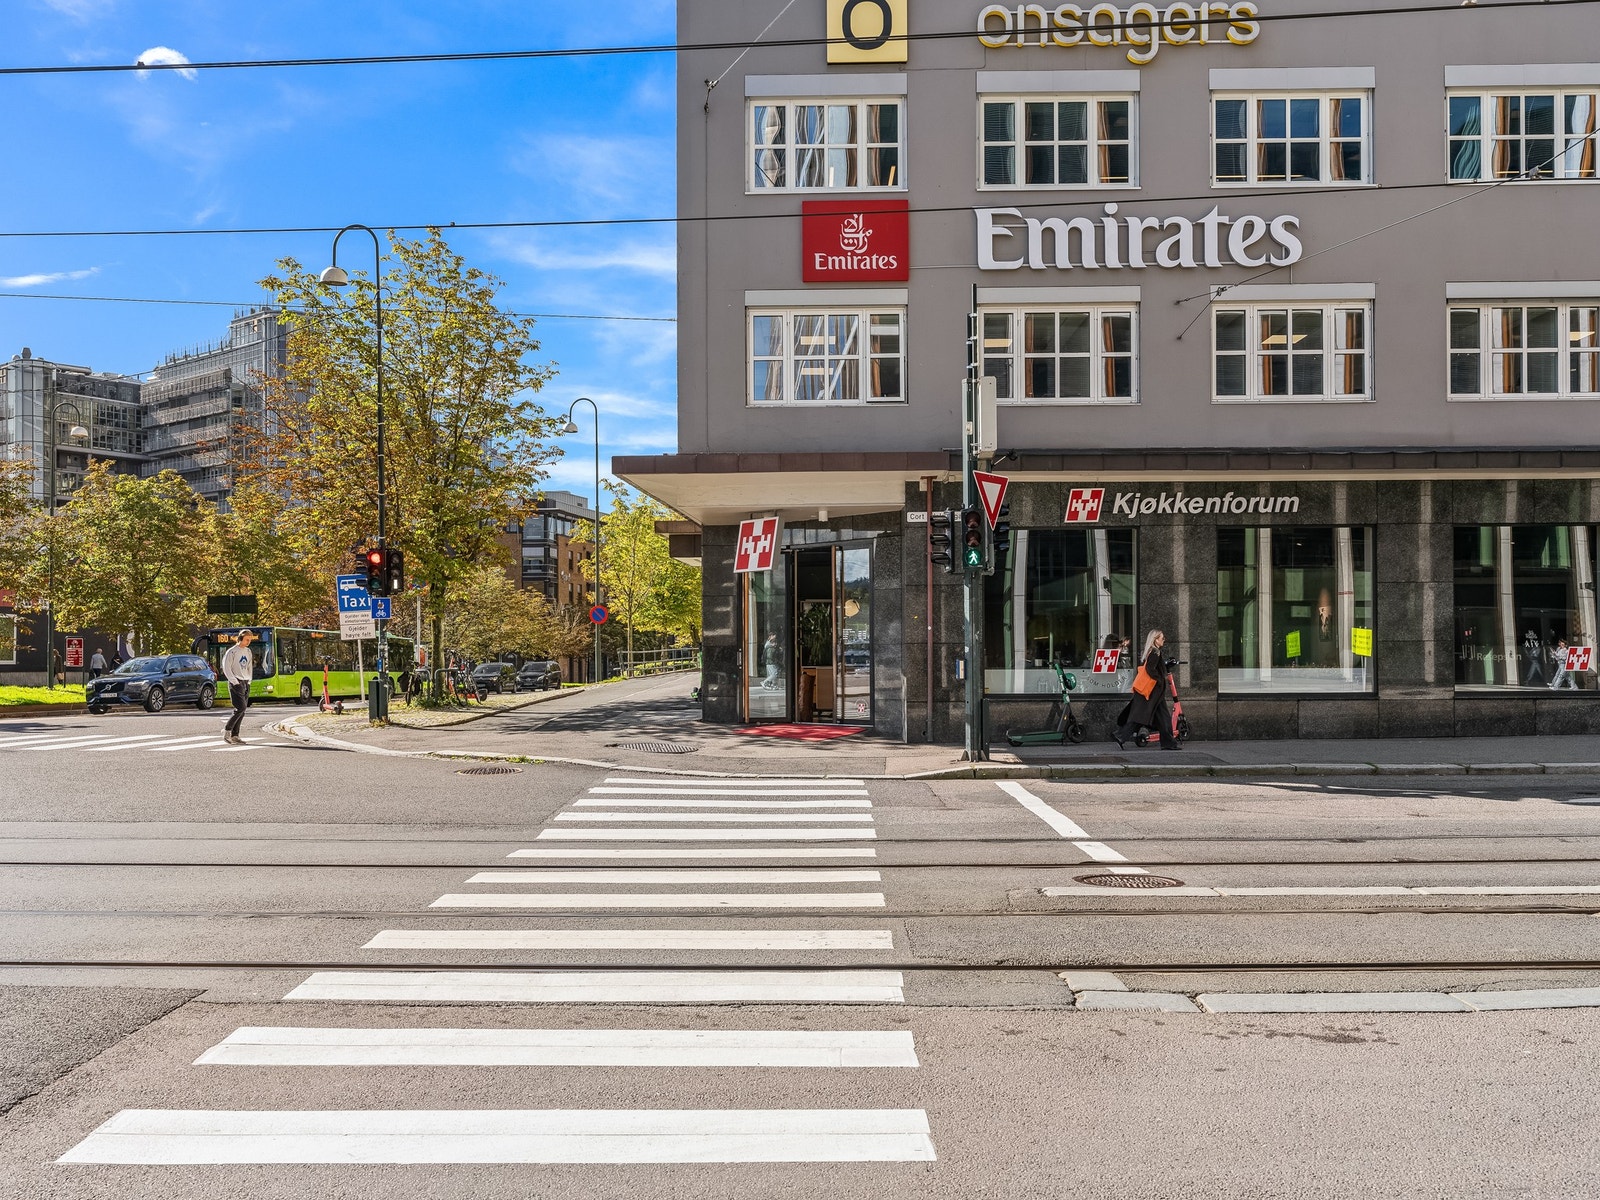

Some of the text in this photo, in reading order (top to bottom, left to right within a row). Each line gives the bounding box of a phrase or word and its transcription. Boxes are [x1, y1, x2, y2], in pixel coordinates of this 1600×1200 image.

[977, 1, 1260, 65] onsagers
[971, 202, 1303, 270] Emirates
[814, 252, 898, 270] Emirates
[1112, 491, 1300, 519] Kjøkkenforum
[341, 595, 371, 608] Taxi
